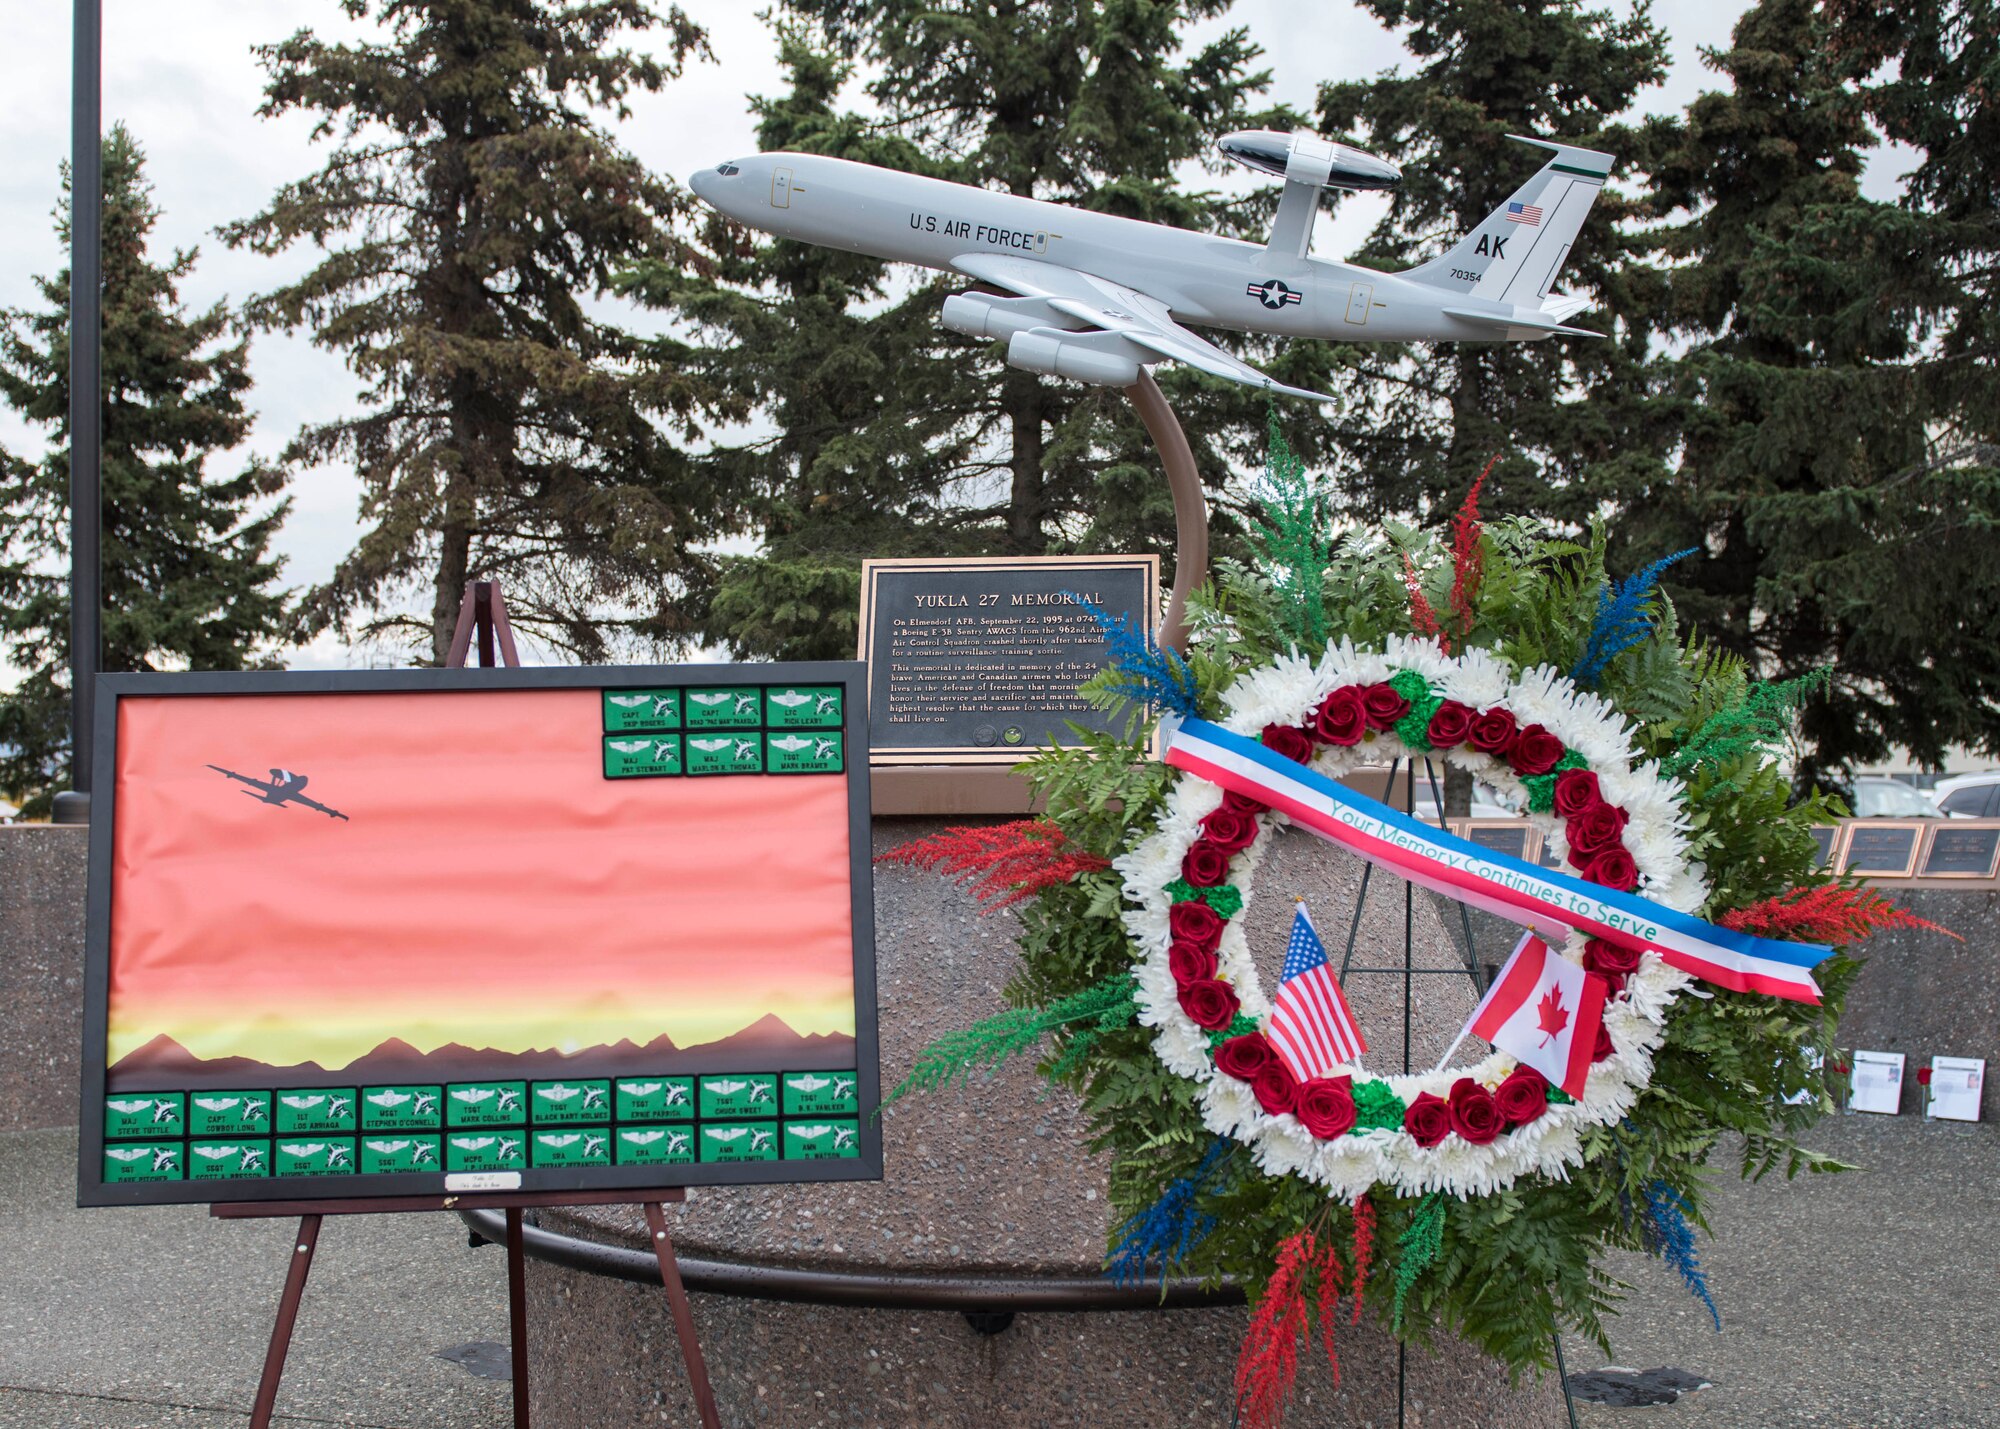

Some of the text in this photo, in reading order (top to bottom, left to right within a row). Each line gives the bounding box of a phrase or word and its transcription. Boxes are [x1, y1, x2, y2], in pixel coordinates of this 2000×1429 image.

[910, 213, 1034, 250] U.S. AIR FORCE
[1474, 233, 1509, 260] AK
[1450, 268, 1481, 283] 70354
[914, 592, 1104, 607] YUKLA 27 MEMORIAL
[910, 618, 951, 626] Elmendorf
[956, 618, 976, 626] AFB,
[980, 617, 1022, 627] September
[1026, 616, 1039, 624] 22,
[1043, 616, 1063, 624] 1995
[1076, 615, 1098, 623] 0747
[902, 629, 928, 637] Boeing
[932, 628, 952, 636] E-3B
[957, 628, 983, 636] Sentry
[986, 627, 1017, 635] AWACS
[1020, 626, 1039, 634] from
[1059, 625, 1086, 634] 962nd
[892, 635, 1105, 648] Air Control Squadron crashed shortly after takeoff
[948, 648, 997, 656] surveillance
[1002, 648, 1034, 656] training
[913, 663, 951, 671] memorial
[954, 663, 962, 671] is
[965, 663, 1005, 671] dedicated
[1019, 664, 1052, 672] memory
[1055, 662, 1064, 670] of
[1068, 662, 1081, 670] the
[1085, 662, 1097, 670] 24
[1075, 672, 1091, 680] lost
[890, 684, 910, 692] lives
[977, 683, 986, 691] of
[991, 693, 1027, 701] sacrifice
[889, 704, 920, 712] highest
[1024, 703, 1036, 711] for
[1040, 703, 1064, 711] which
[1069, 703, 1088, 712] they
[915, 714, 930, 722] live
[636, 765, 666, 773] STEWART
[1331, 798, 1657, 941] Your Memory Continues to Serve
[118, 1127, 140, 1135] STEVE
